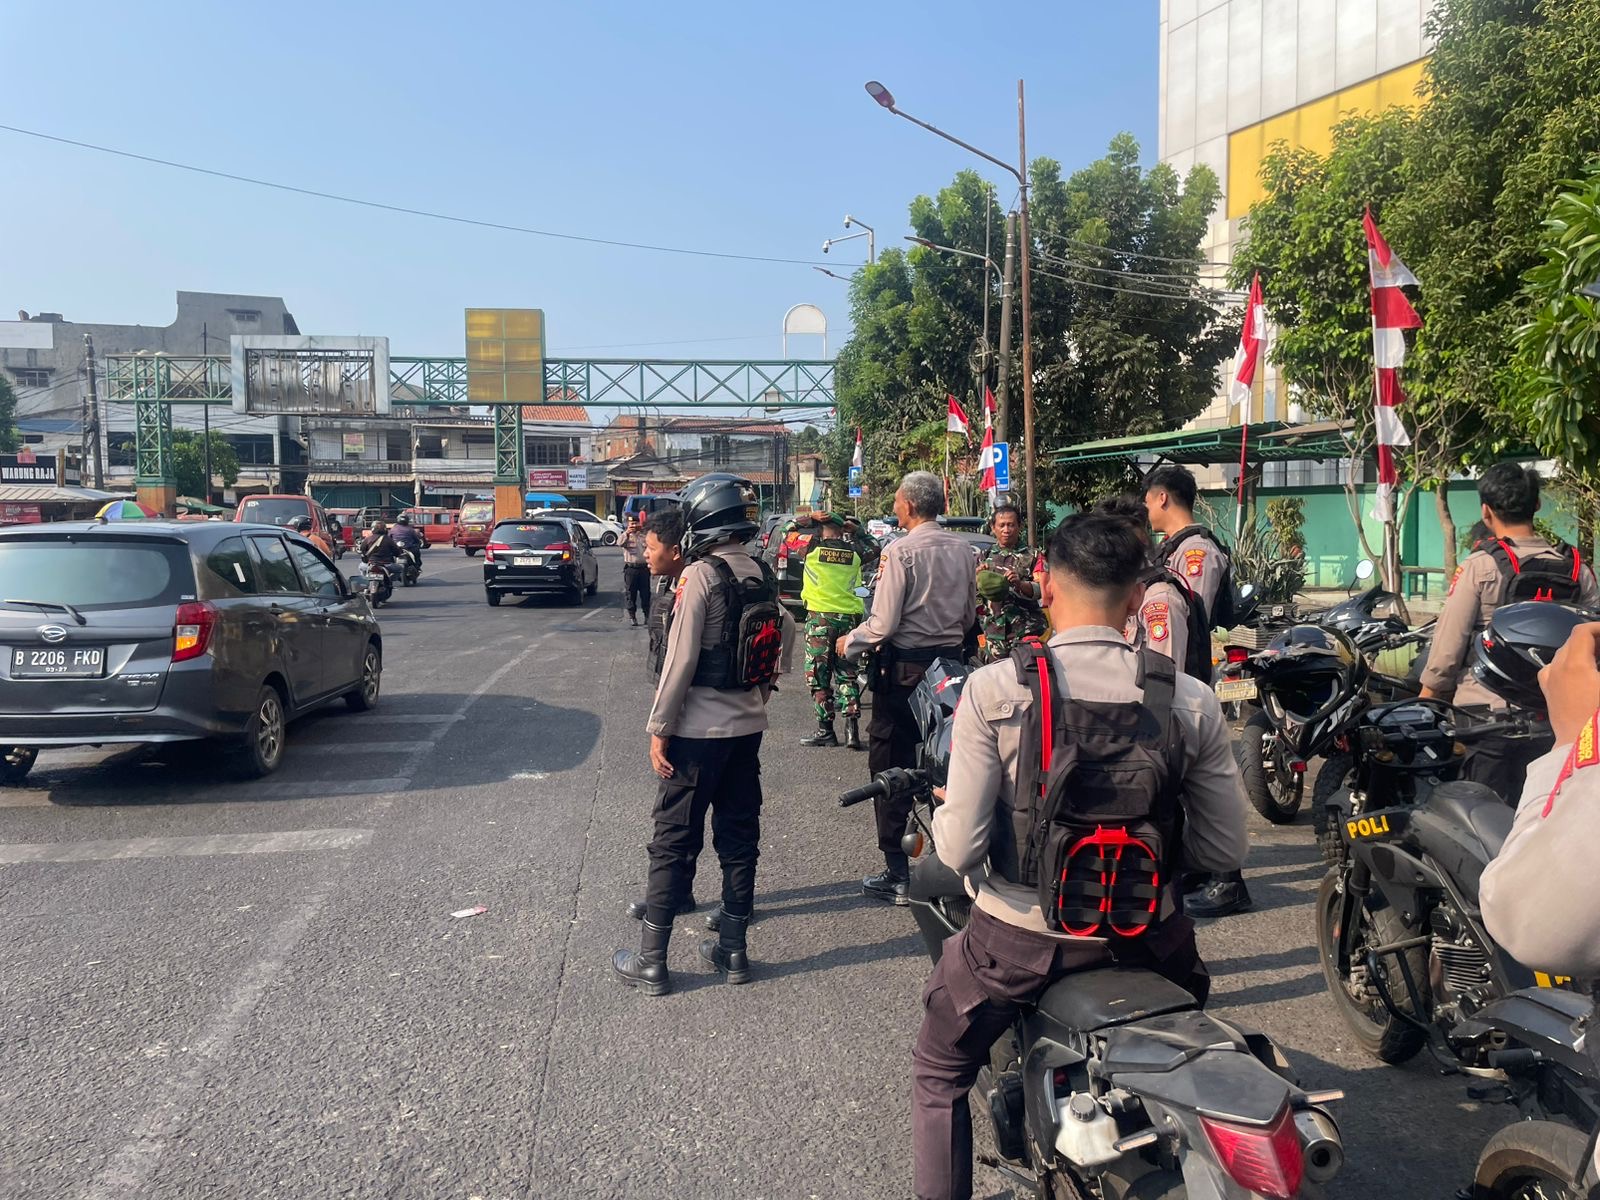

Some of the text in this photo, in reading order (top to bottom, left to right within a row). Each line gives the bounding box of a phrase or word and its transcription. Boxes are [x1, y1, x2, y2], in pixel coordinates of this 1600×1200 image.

[1, 467, 34, 480] WARUNG
[35, 467, 55, 480] RAJA
[15, 650, 100, 666] B 2206 FKD
[1347, 815, 1390, 839] POLI
